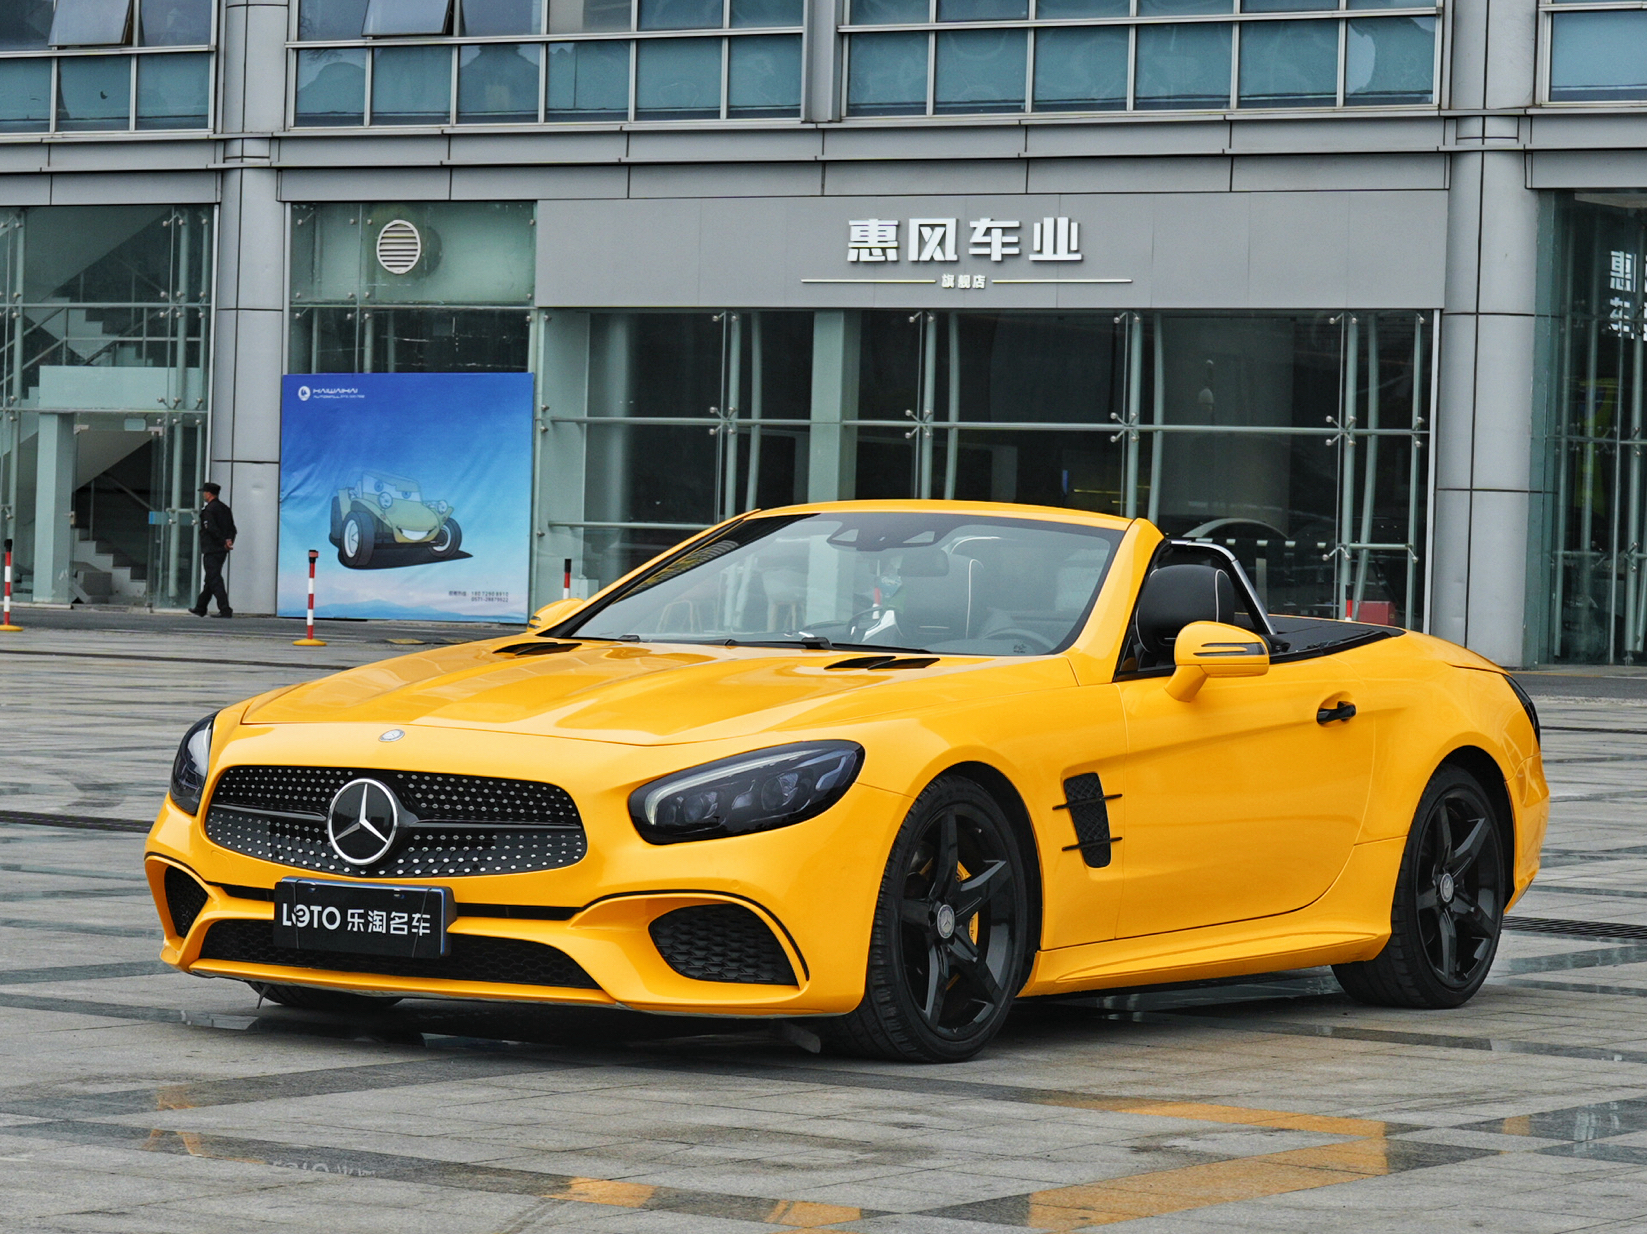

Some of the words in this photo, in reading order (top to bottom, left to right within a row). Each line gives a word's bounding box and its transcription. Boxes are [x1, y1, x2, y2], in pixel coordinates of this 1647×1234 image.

[847, 216, 1083, 262] 惠风车业
[941, 274, 986, 289] 旗舰店
[282, 902, 341, 930] LOTO
[346, 909, 431, 936] 乐淘名车
